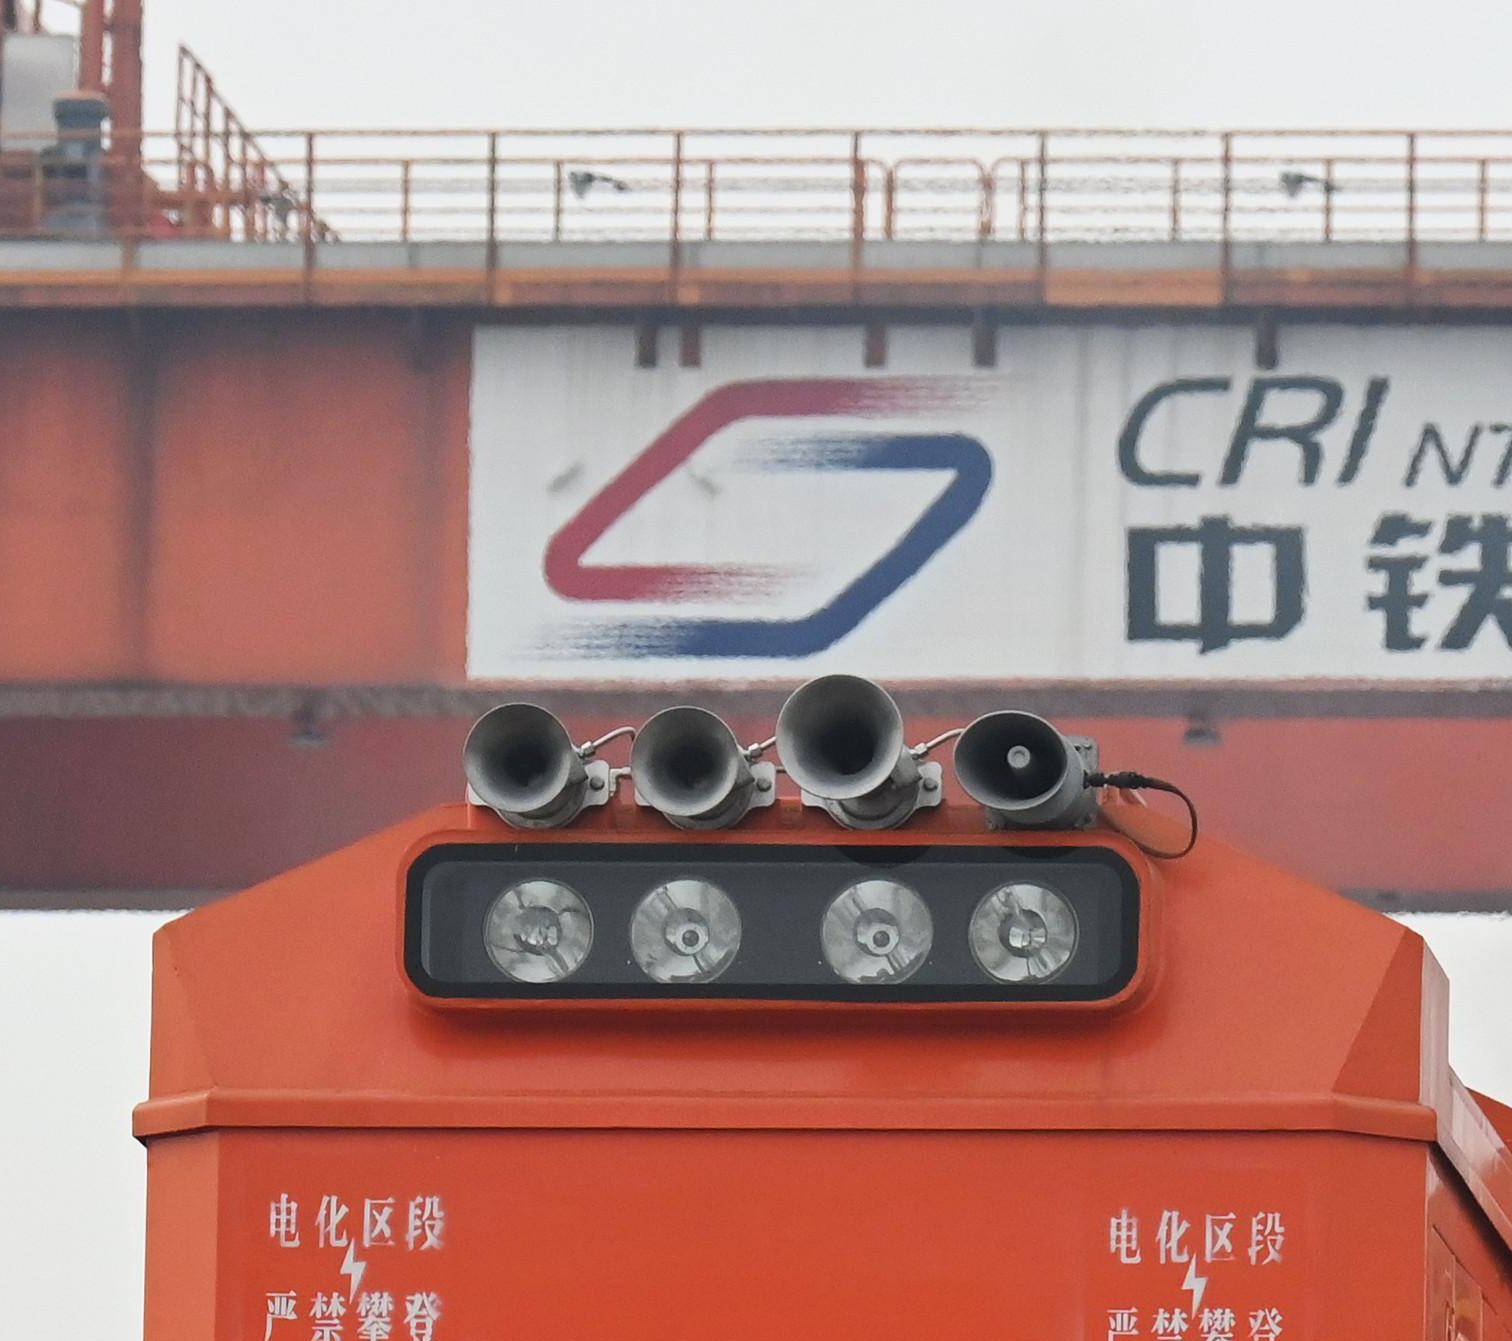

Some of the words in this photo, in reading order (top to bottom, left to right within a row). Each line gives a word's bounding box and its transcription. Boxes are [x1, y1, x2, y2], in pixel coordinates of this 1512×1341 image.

[268, 1193, 447, 1252] 电化区段
[1106, 1208, 1287, 1267] 电化区段
